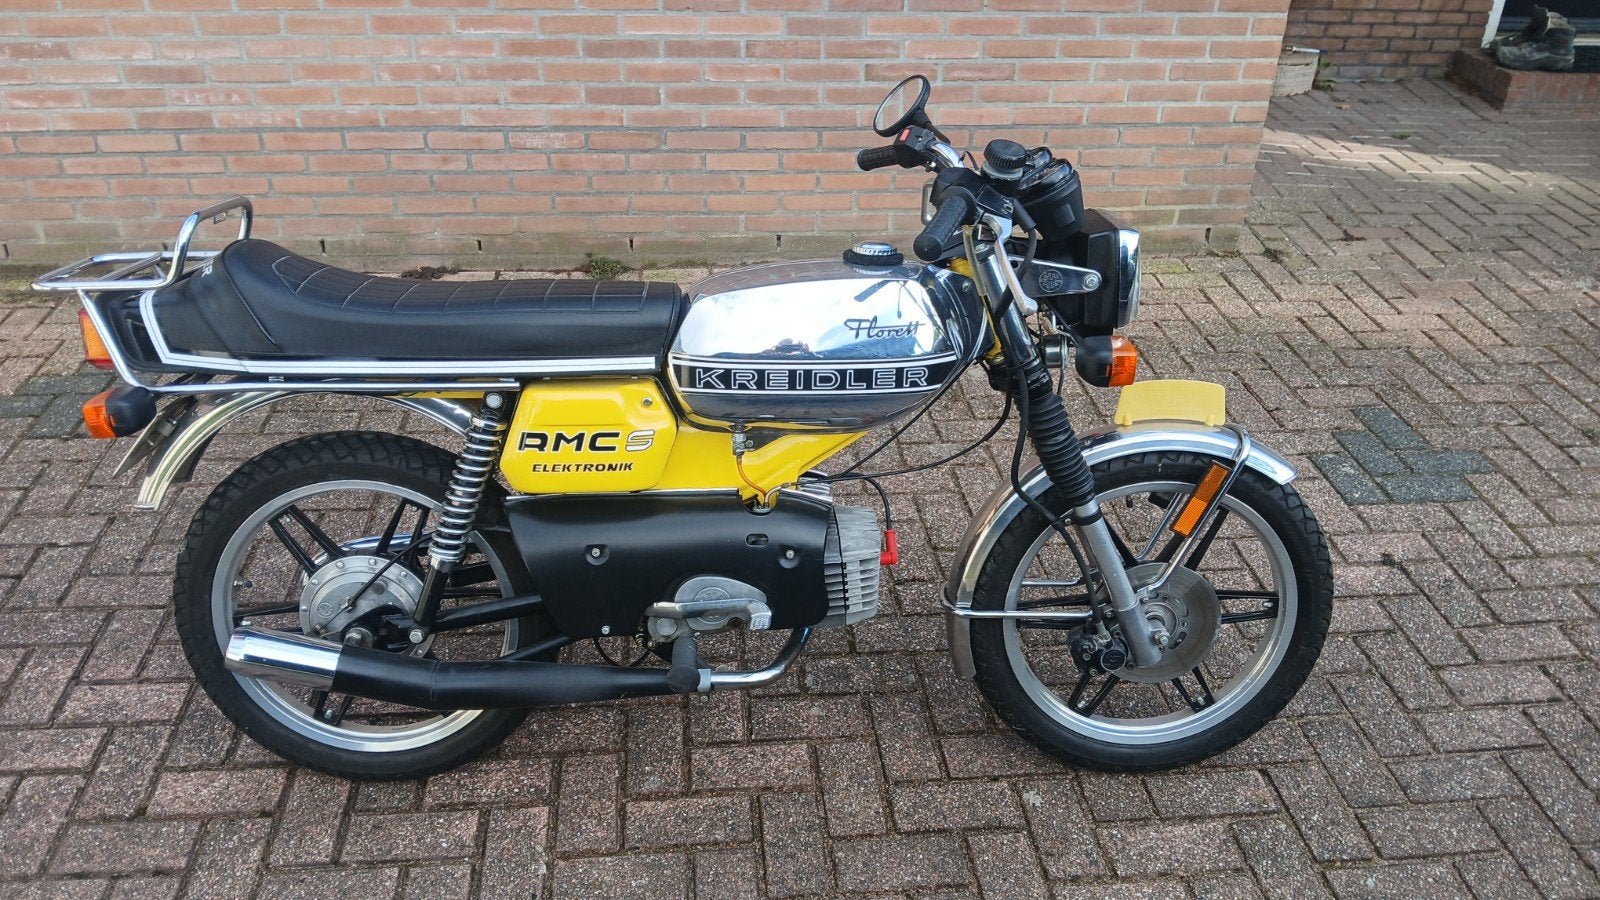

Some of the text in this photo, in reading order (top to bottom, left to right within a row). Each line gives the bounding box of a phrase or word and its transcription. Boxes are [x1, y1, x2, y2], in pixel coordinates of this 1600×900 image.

[843, 315, 926, 340] Florett
[695, 366, 929, 390] KREIDLER
[532, 462, 634, 473] ELEKTRONIK
